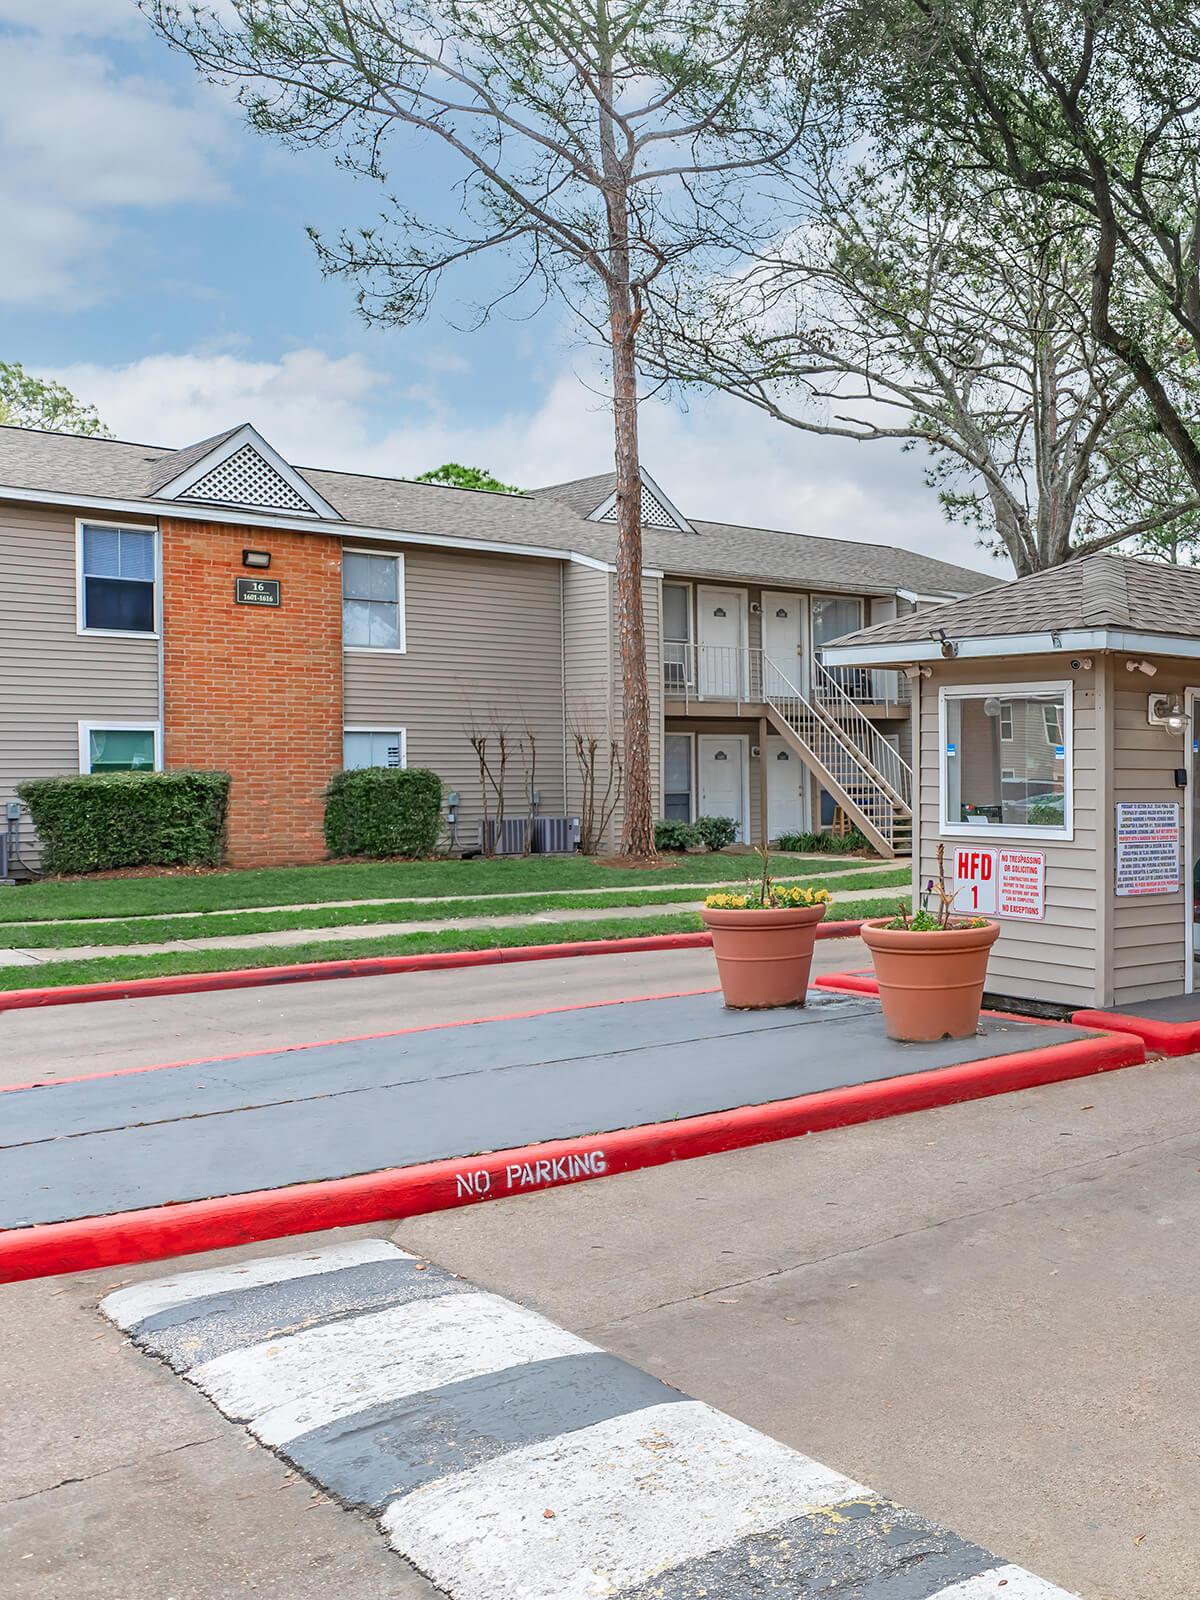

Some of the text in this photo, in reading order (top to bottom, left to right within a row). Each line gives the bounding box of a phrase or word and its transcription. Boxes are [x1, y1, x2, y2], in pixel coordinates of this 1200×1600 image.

[252, 582, 264, 591] 16
[243, 593, 273, 602] 1601-1616
[1001, 854, 1041, 865] NO TRESPASSING
[958, 852, 992, 881] HFD
[1004, 864, 1038, 875] OR SOLICITING
[971, 885, 978, 909] 1
[1002, 904, 1039, 915] NO EXCEPTIONS
[455, 1150, 607, 1197] NO PARKING
